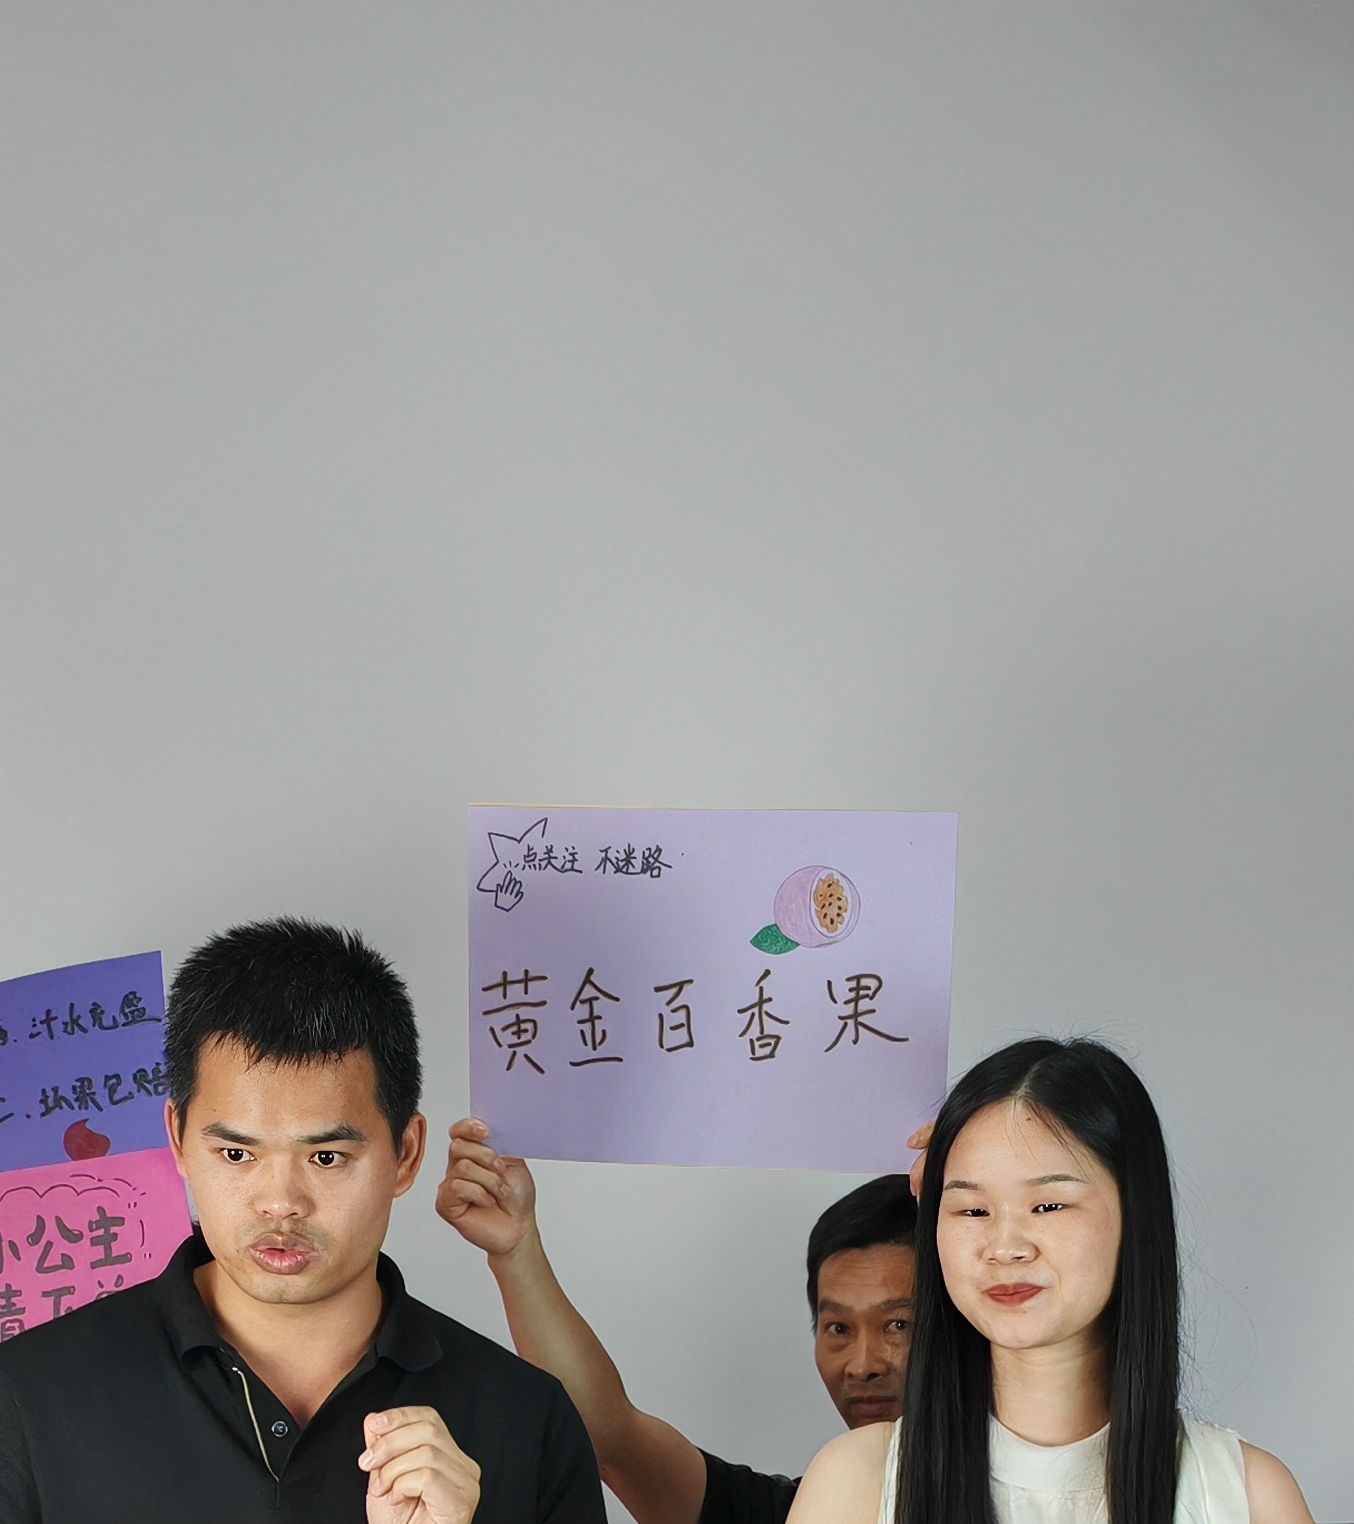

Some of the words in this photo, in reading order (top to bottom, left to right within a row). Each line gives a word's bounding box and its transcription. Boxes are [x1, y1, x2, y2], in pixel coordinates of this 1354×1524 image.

[521, 847, 583, 874] 点关注
[594, 845, 673, 879] 不迷路
[481, 967, 909, 1075] 黄金百香果
